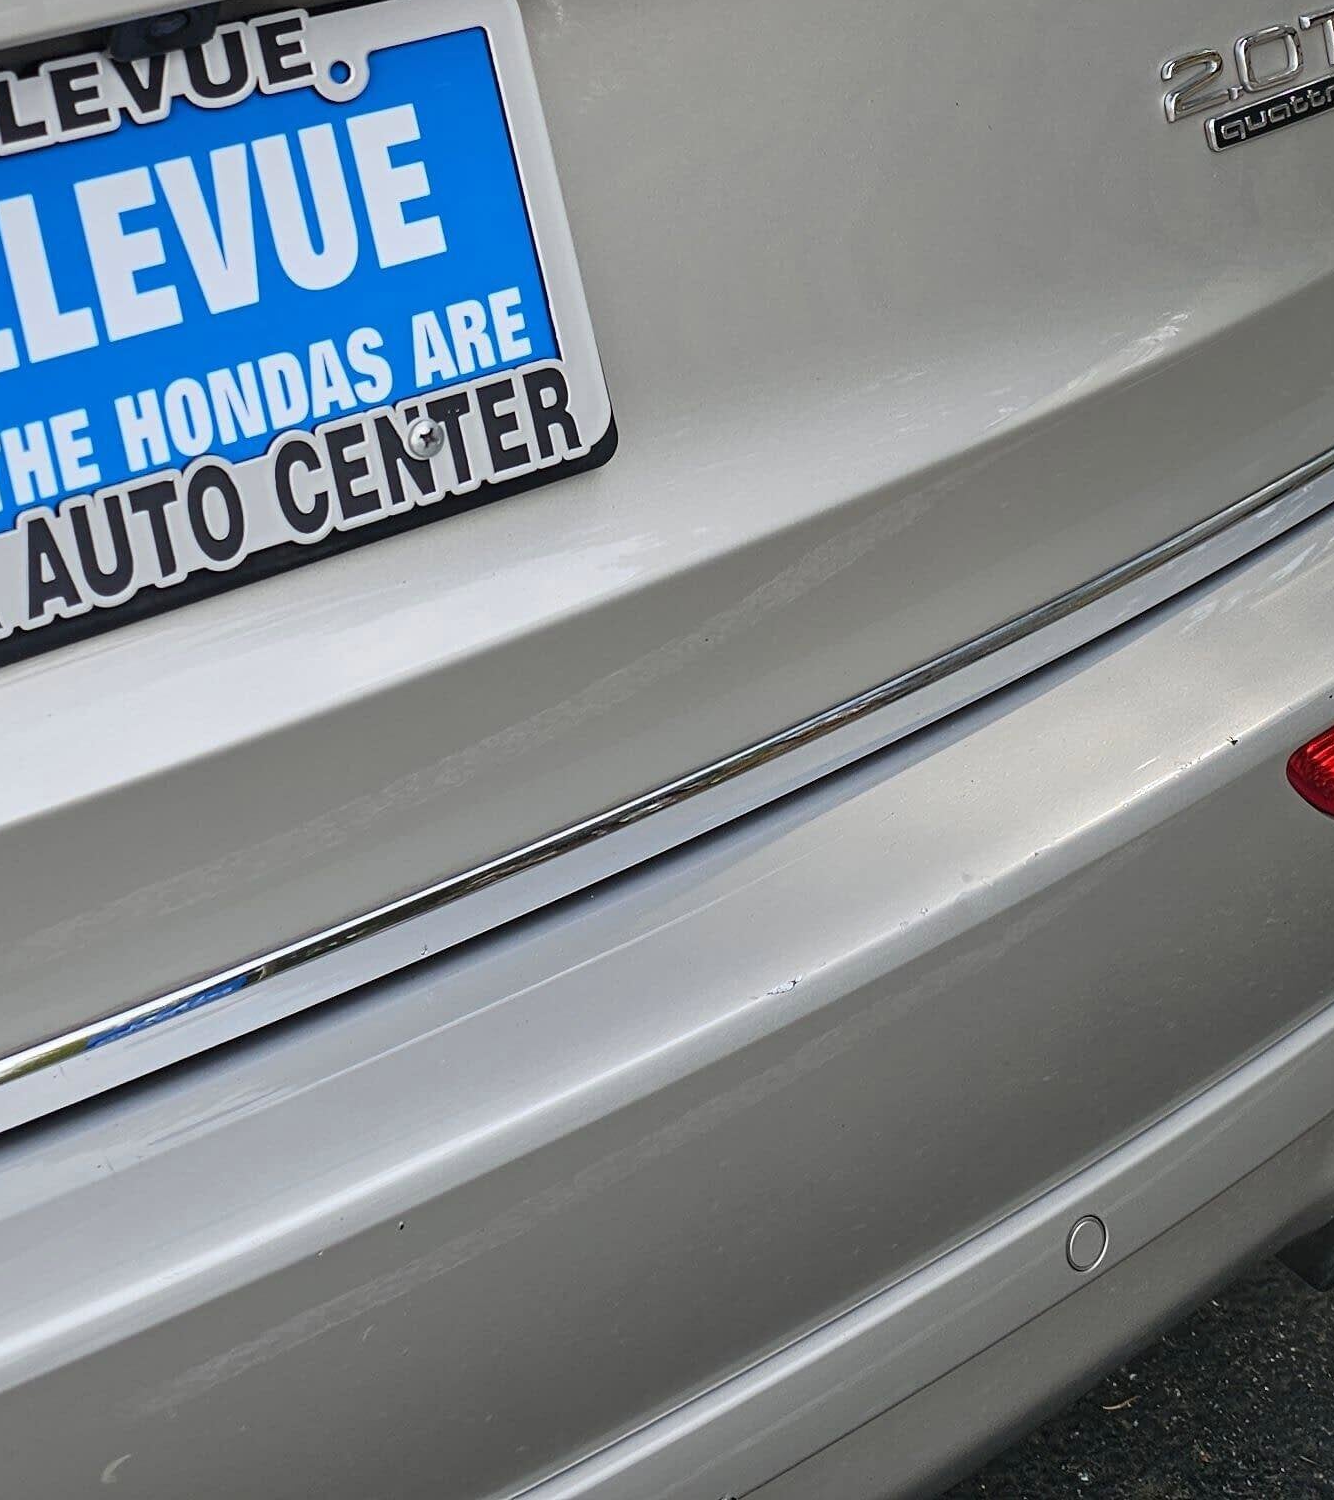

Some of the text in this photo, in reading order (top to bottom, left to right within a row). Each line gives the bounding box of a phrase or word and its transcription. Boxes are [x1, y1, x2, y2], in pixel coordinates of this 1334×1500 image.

[113, 326, 394, 473] HONDAS
[410, 286, 533, 389] ARE
[24, 464, 247, 621] AUTO
[274, 366, 583, 535] CENTER
